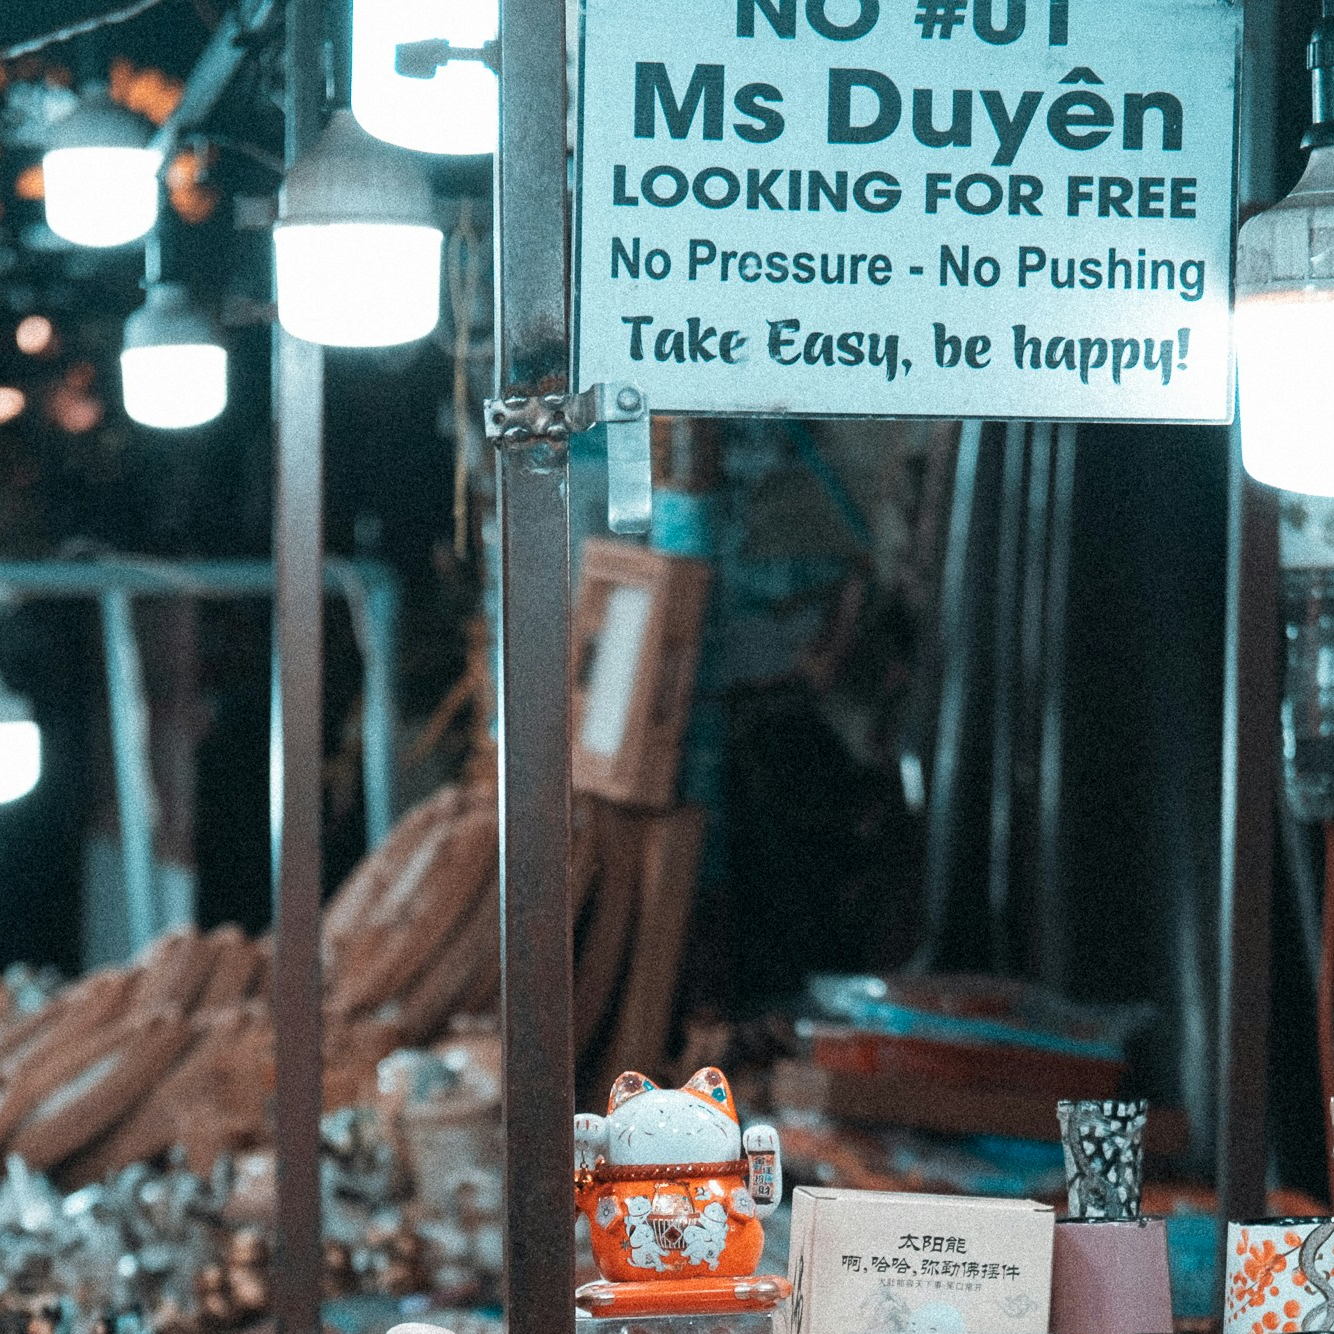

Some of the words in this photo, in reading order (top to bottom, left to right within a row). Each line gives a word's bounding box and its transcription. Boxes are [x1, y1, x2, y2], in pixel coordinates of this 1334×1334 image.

[736, 0, 880, 42] NO
[634, 61, 786, 145] Ms
[827, 66, 1185, 168] Duyên
[613, 164, 903, 215] LOOKING
[925, 172, 1045, 217] FOR
[1067, 175, 1199, 220] FREE
[611, 236, 673, 282] No
[688, 238, 894, 287] Pressure
[939, 244, 1002, 289] No
[1018, 246, 1206, 301] Pushing
[621, 315, 748, 365] Take
[767, 318, 913, 383] Easy,
[933, 322, 992, 370] be
[1012, 323, 1191, 385] happy!
[898, 1233, 968, 1255] 太阳能
